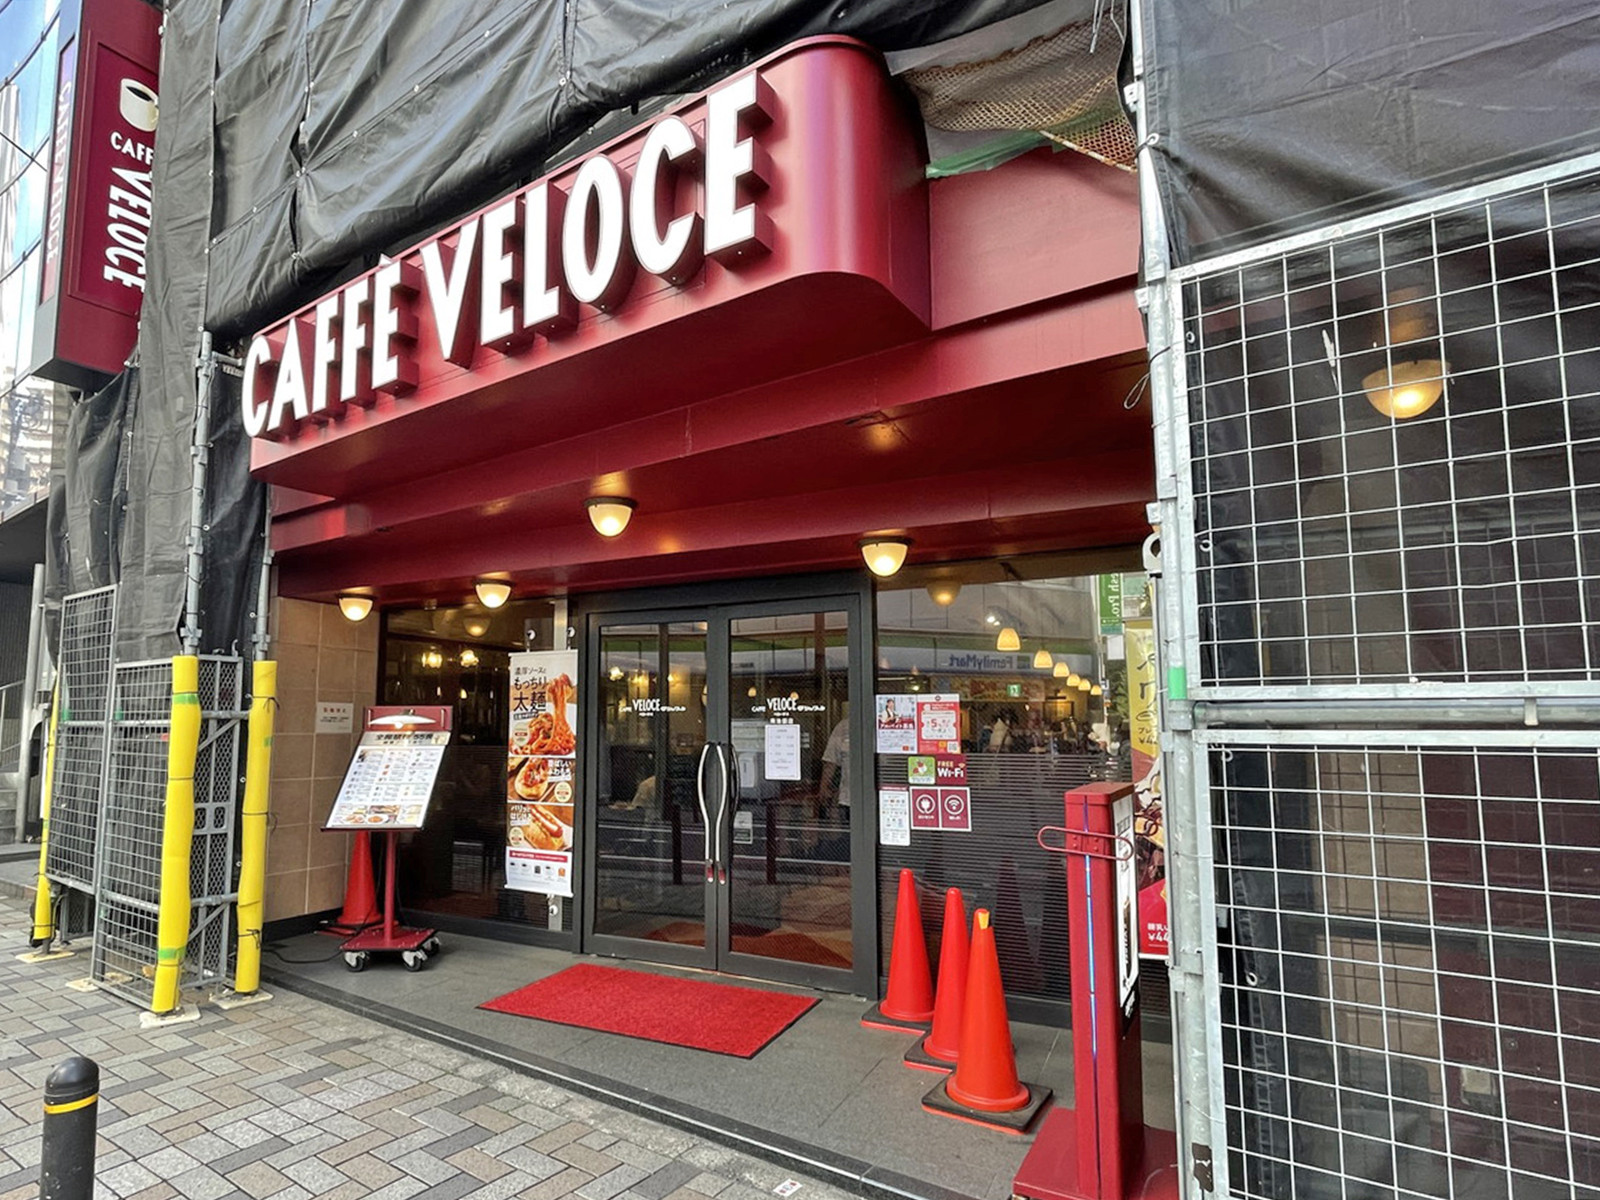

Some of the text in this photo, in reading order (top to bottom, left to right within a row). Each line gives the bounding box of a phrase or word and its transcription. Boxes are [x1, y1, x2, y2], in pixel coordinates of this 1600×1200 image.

[110, 131, 155, 165] CAFF
[420, 70, 757, 361] VELOCE
[103, 166, 153, 293] VELOCE
[514, 677, 547, 690] もっちり
[513, 691, 547, 713] 太麺
[632, 699, 661, 712] VELOCE
[766, 698, 797, 712] VELOCE
